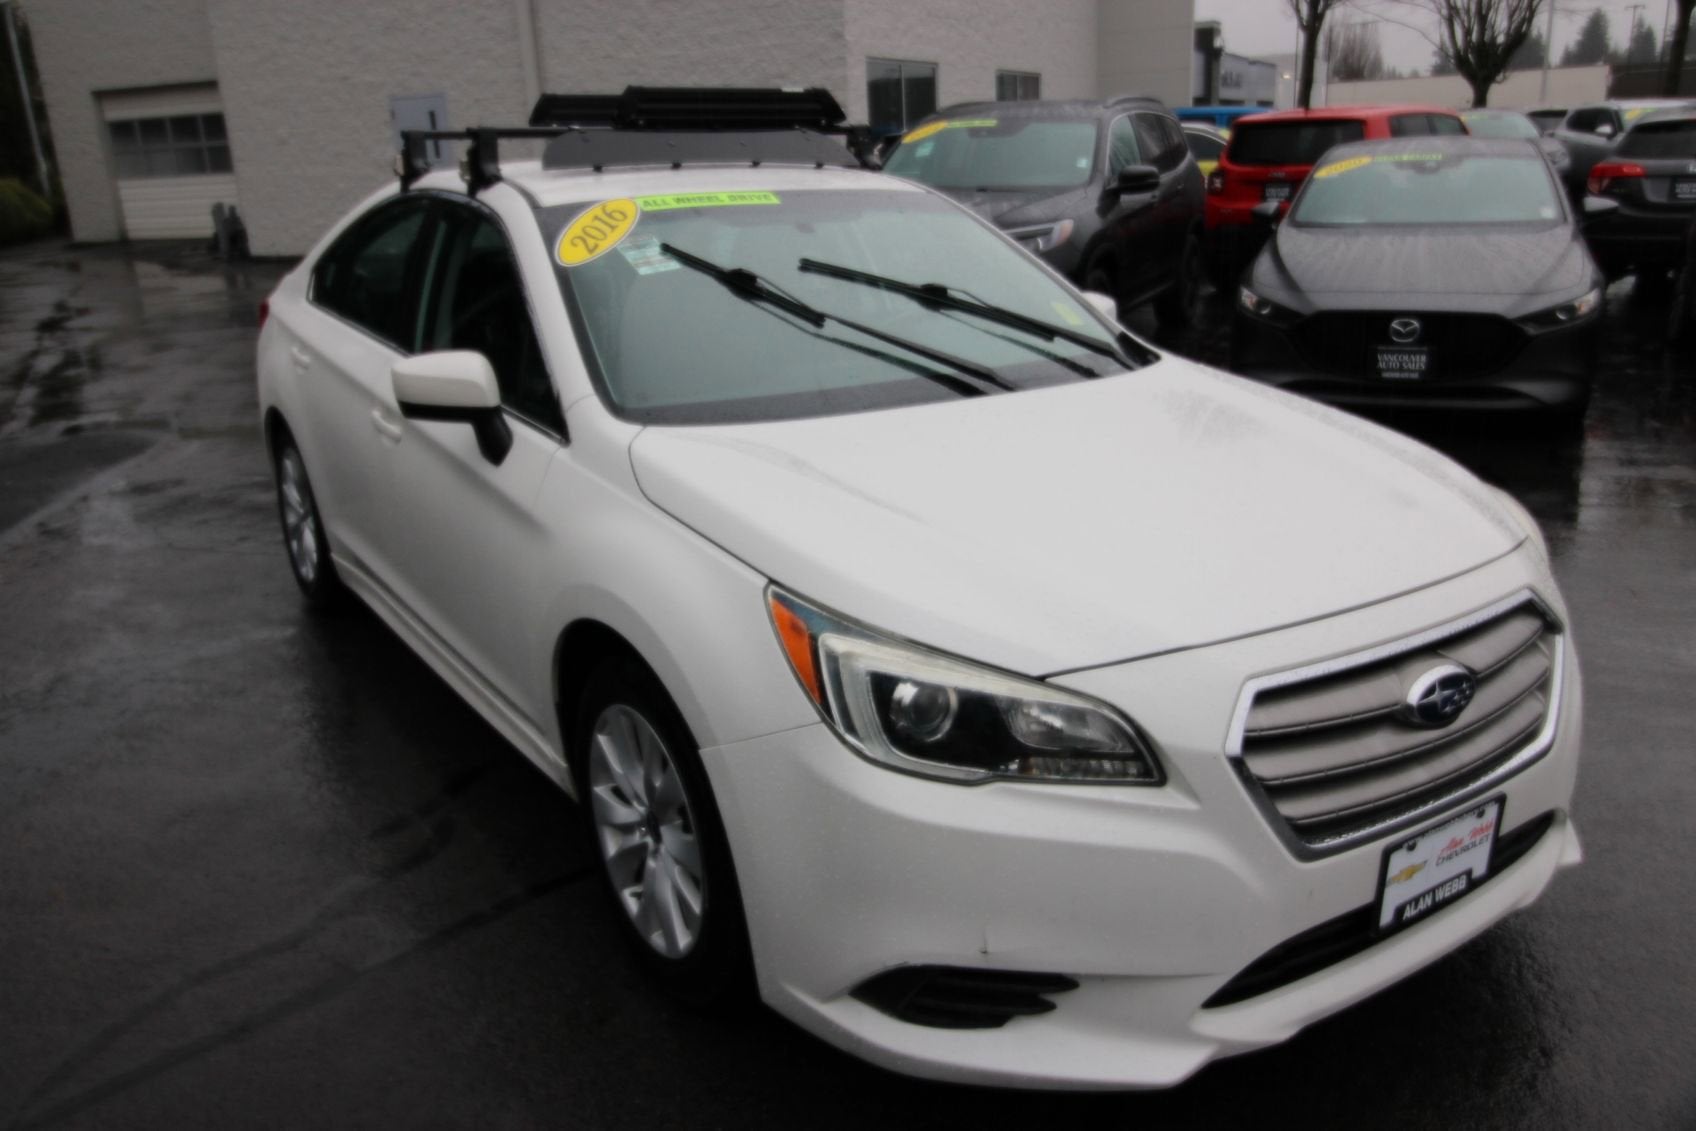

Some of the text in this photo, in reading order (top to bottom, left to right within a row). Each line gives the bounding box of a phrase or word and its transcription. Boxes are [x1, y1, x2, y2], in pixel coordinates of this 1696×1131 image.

[642, 193, 775, 208] ALL WHEEL DRIVE
[570, 204, 628, 255] 2016
[1377, 361, 1425, 369] AUTO SALES
[1436, 834, 1489, 866] CHEVROLET
[1402, 874, 1467, 920] ALAN WEBB
